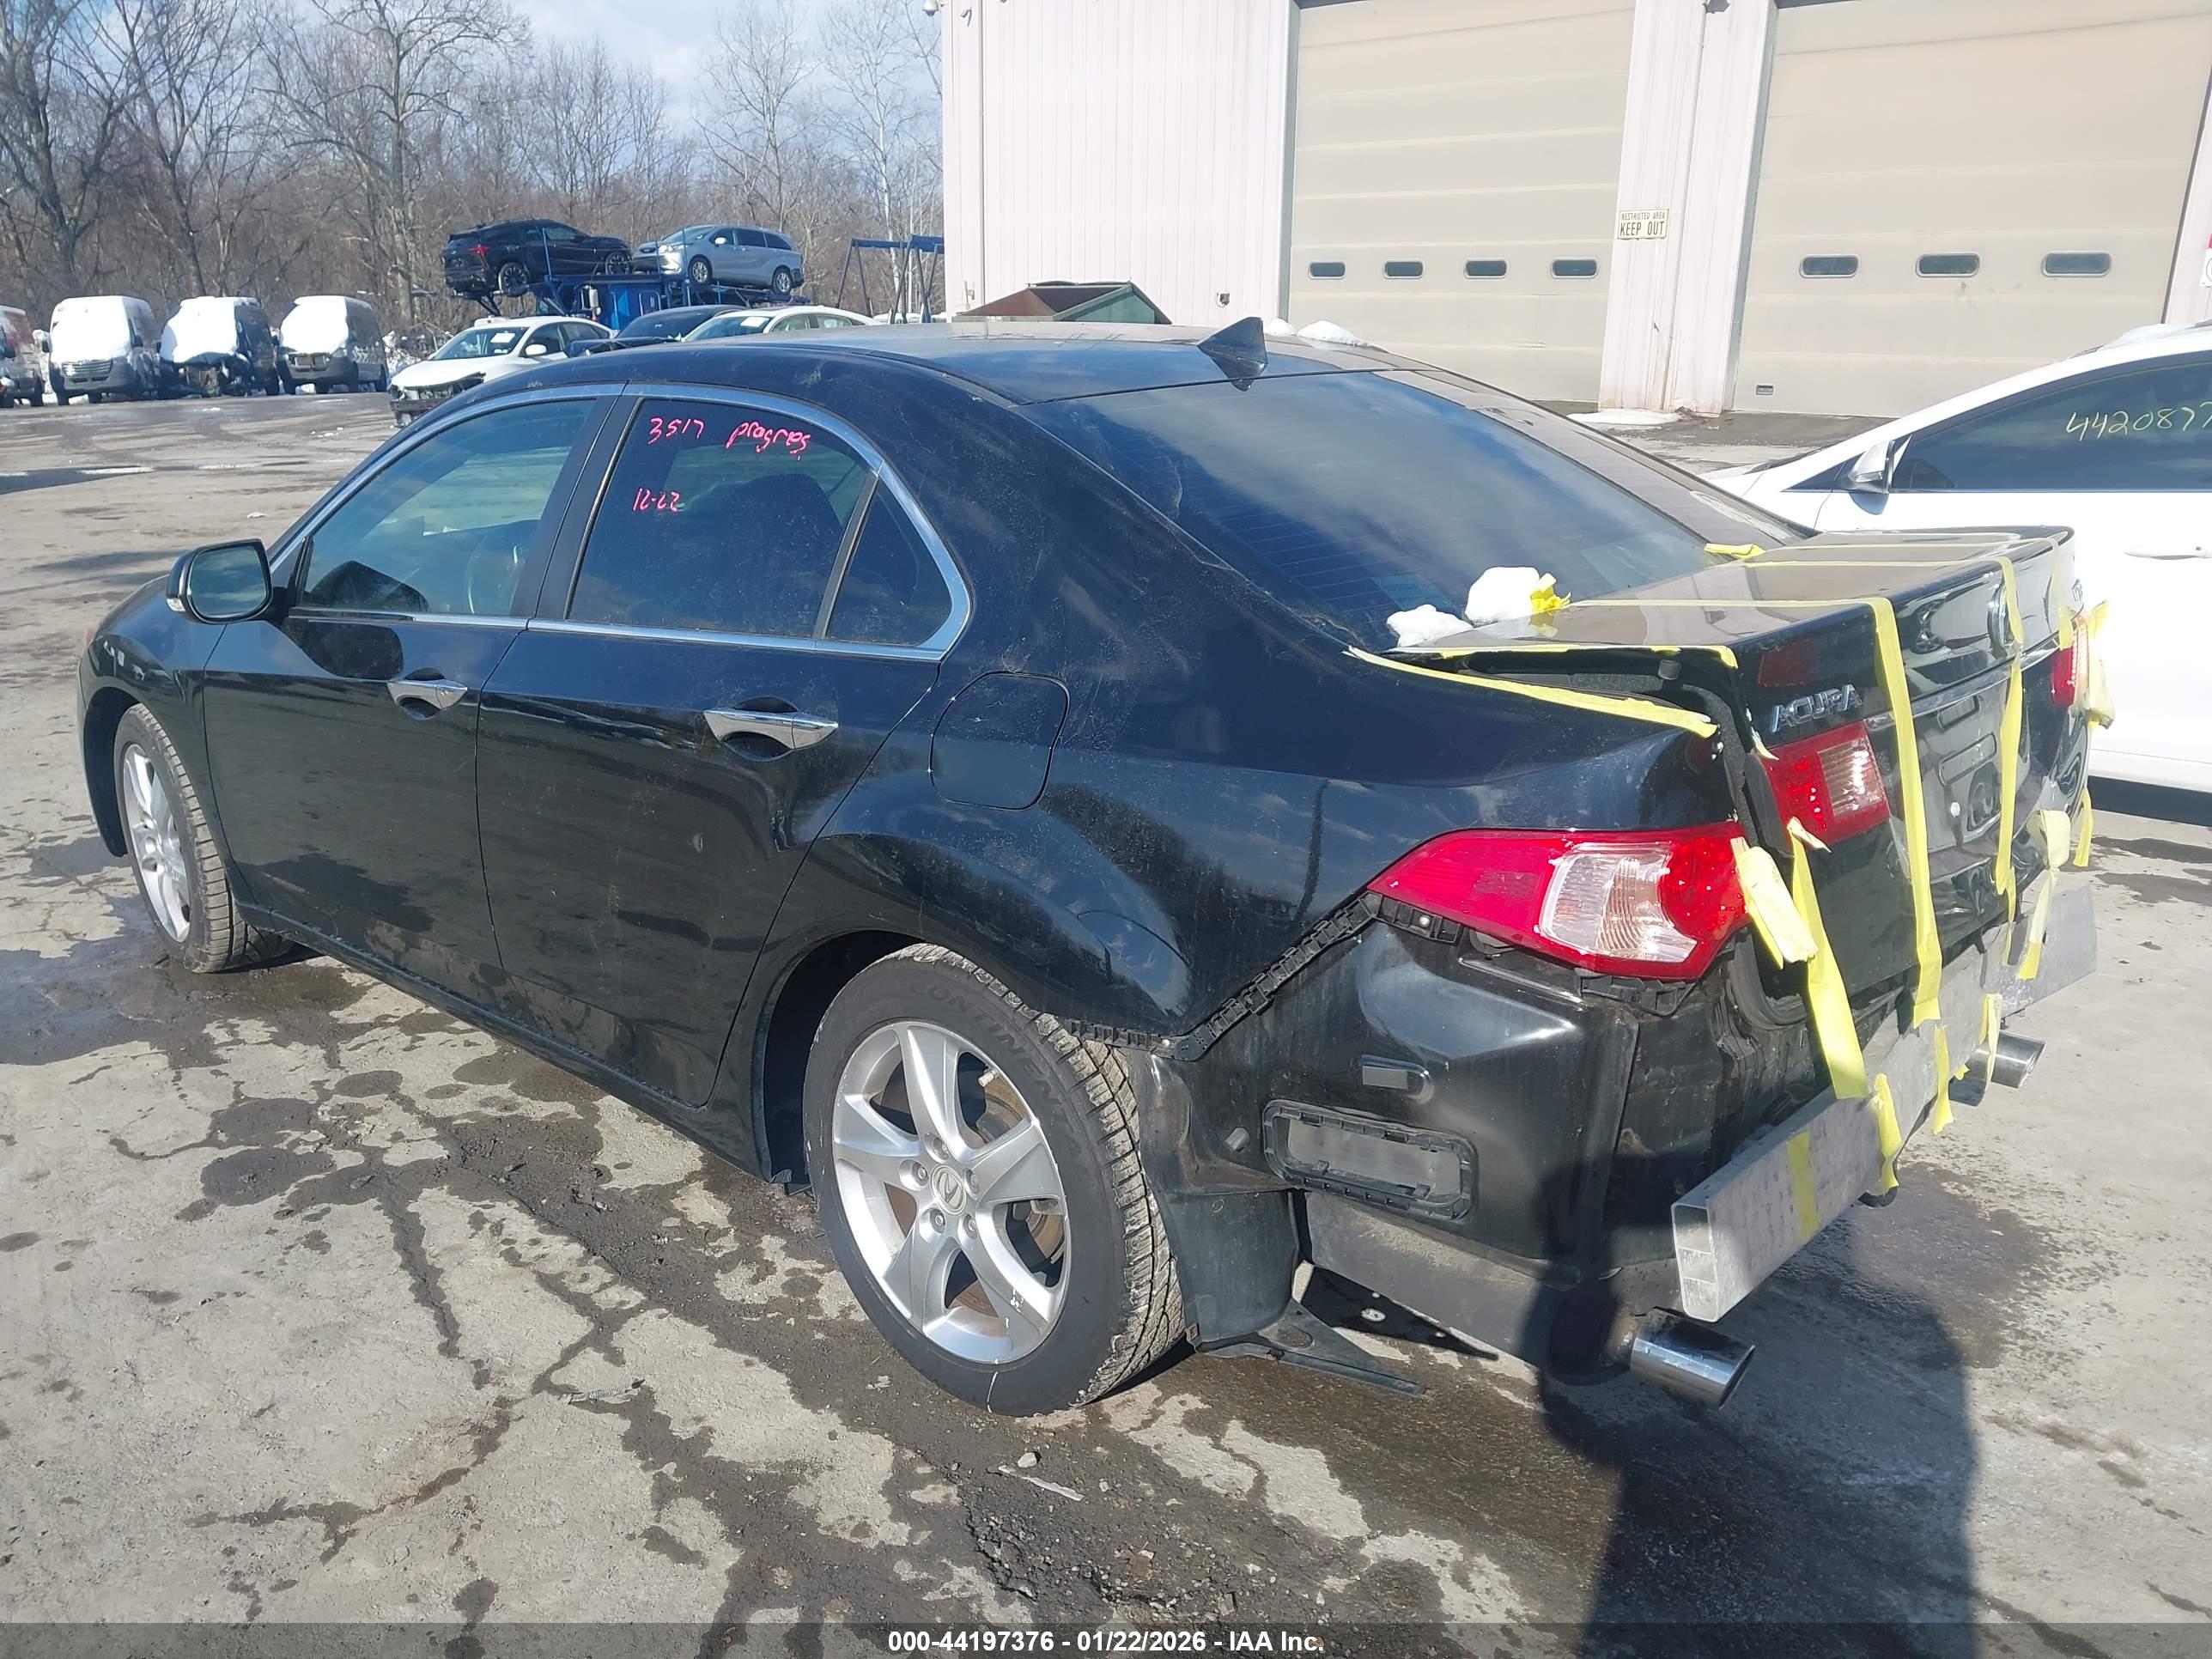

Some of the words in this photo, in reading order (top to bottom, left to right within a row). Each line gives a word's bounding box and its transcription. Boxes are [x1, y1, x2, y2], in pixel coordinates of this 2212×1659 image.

[1653, 211, 1665, 220] AREA
[1620, 222, 1642, 236] KEEP
[1647, 221, 1665, 235] OUT
[1771, 684, 1863, 732] ACURA
